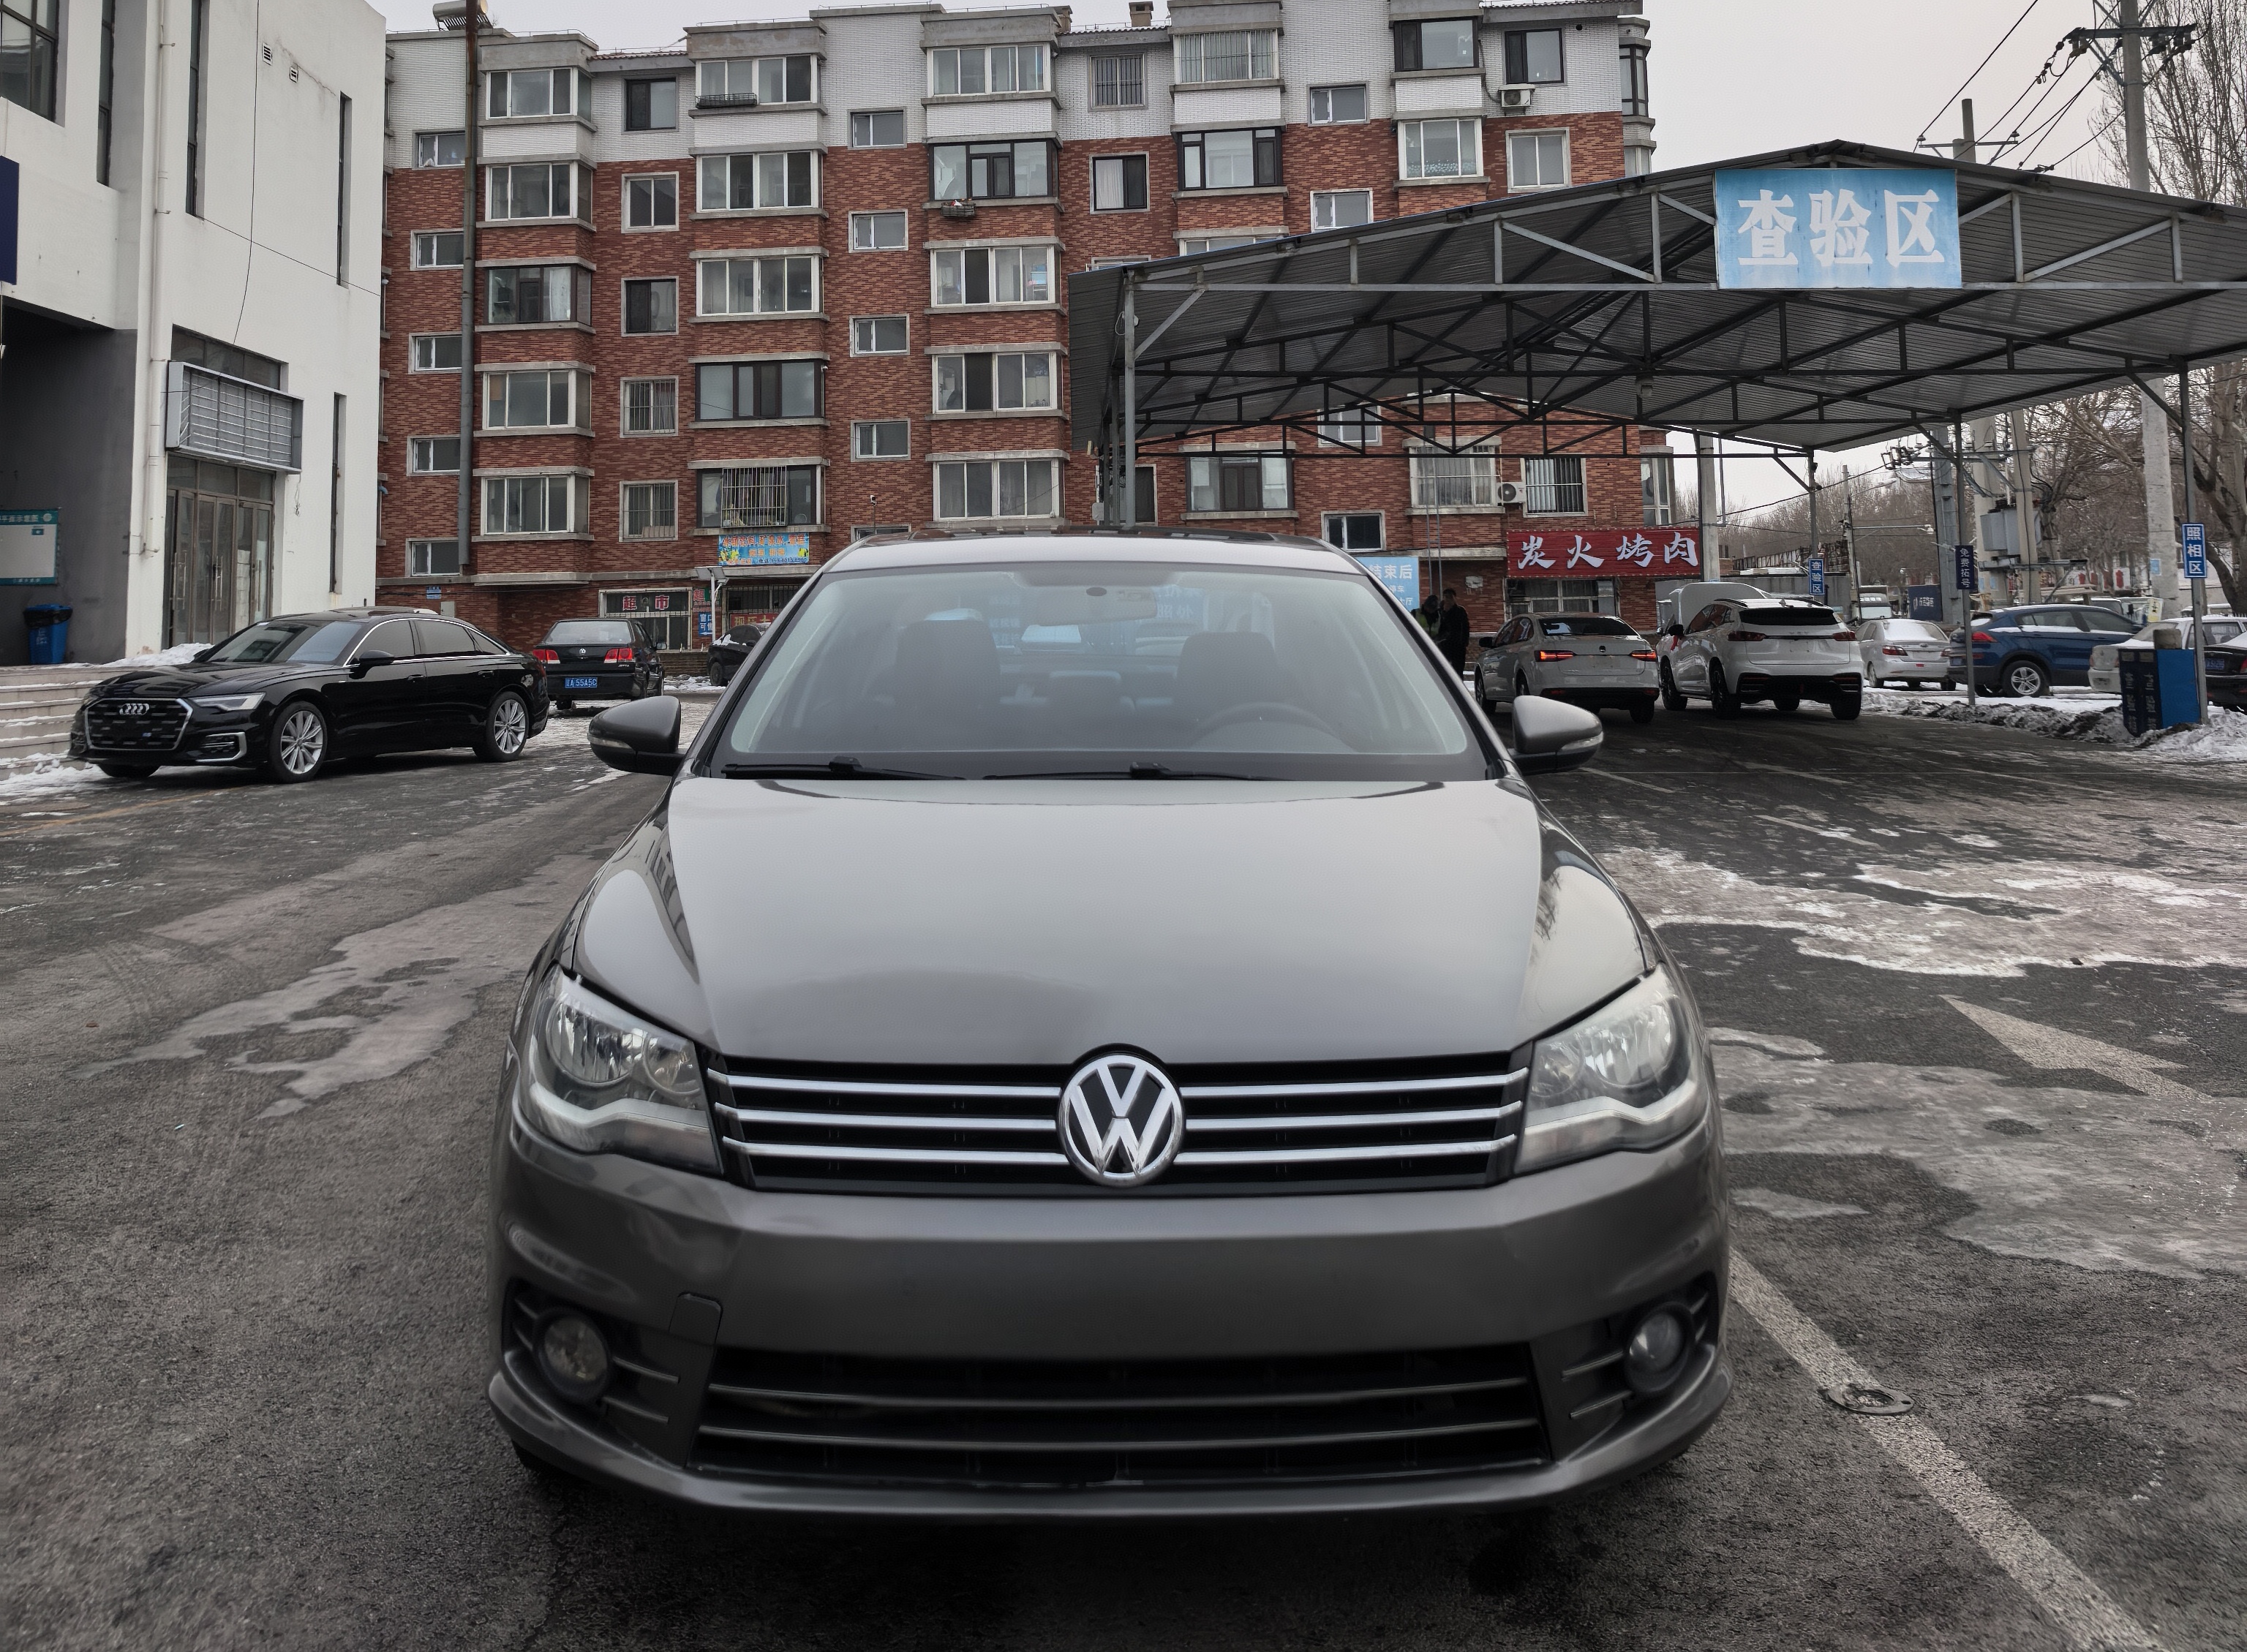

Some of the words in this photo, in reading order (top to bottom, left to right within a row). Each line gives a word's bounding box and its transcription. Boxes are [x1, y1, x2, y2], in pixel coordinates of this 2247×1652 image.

[1738, 189, 1945, 268] 查验区
[1518, 531, 1698, 570] 炭火烤肉
[2186, 527, 2203, 574] 照相区
[622, 595, 669, 611] 超市
